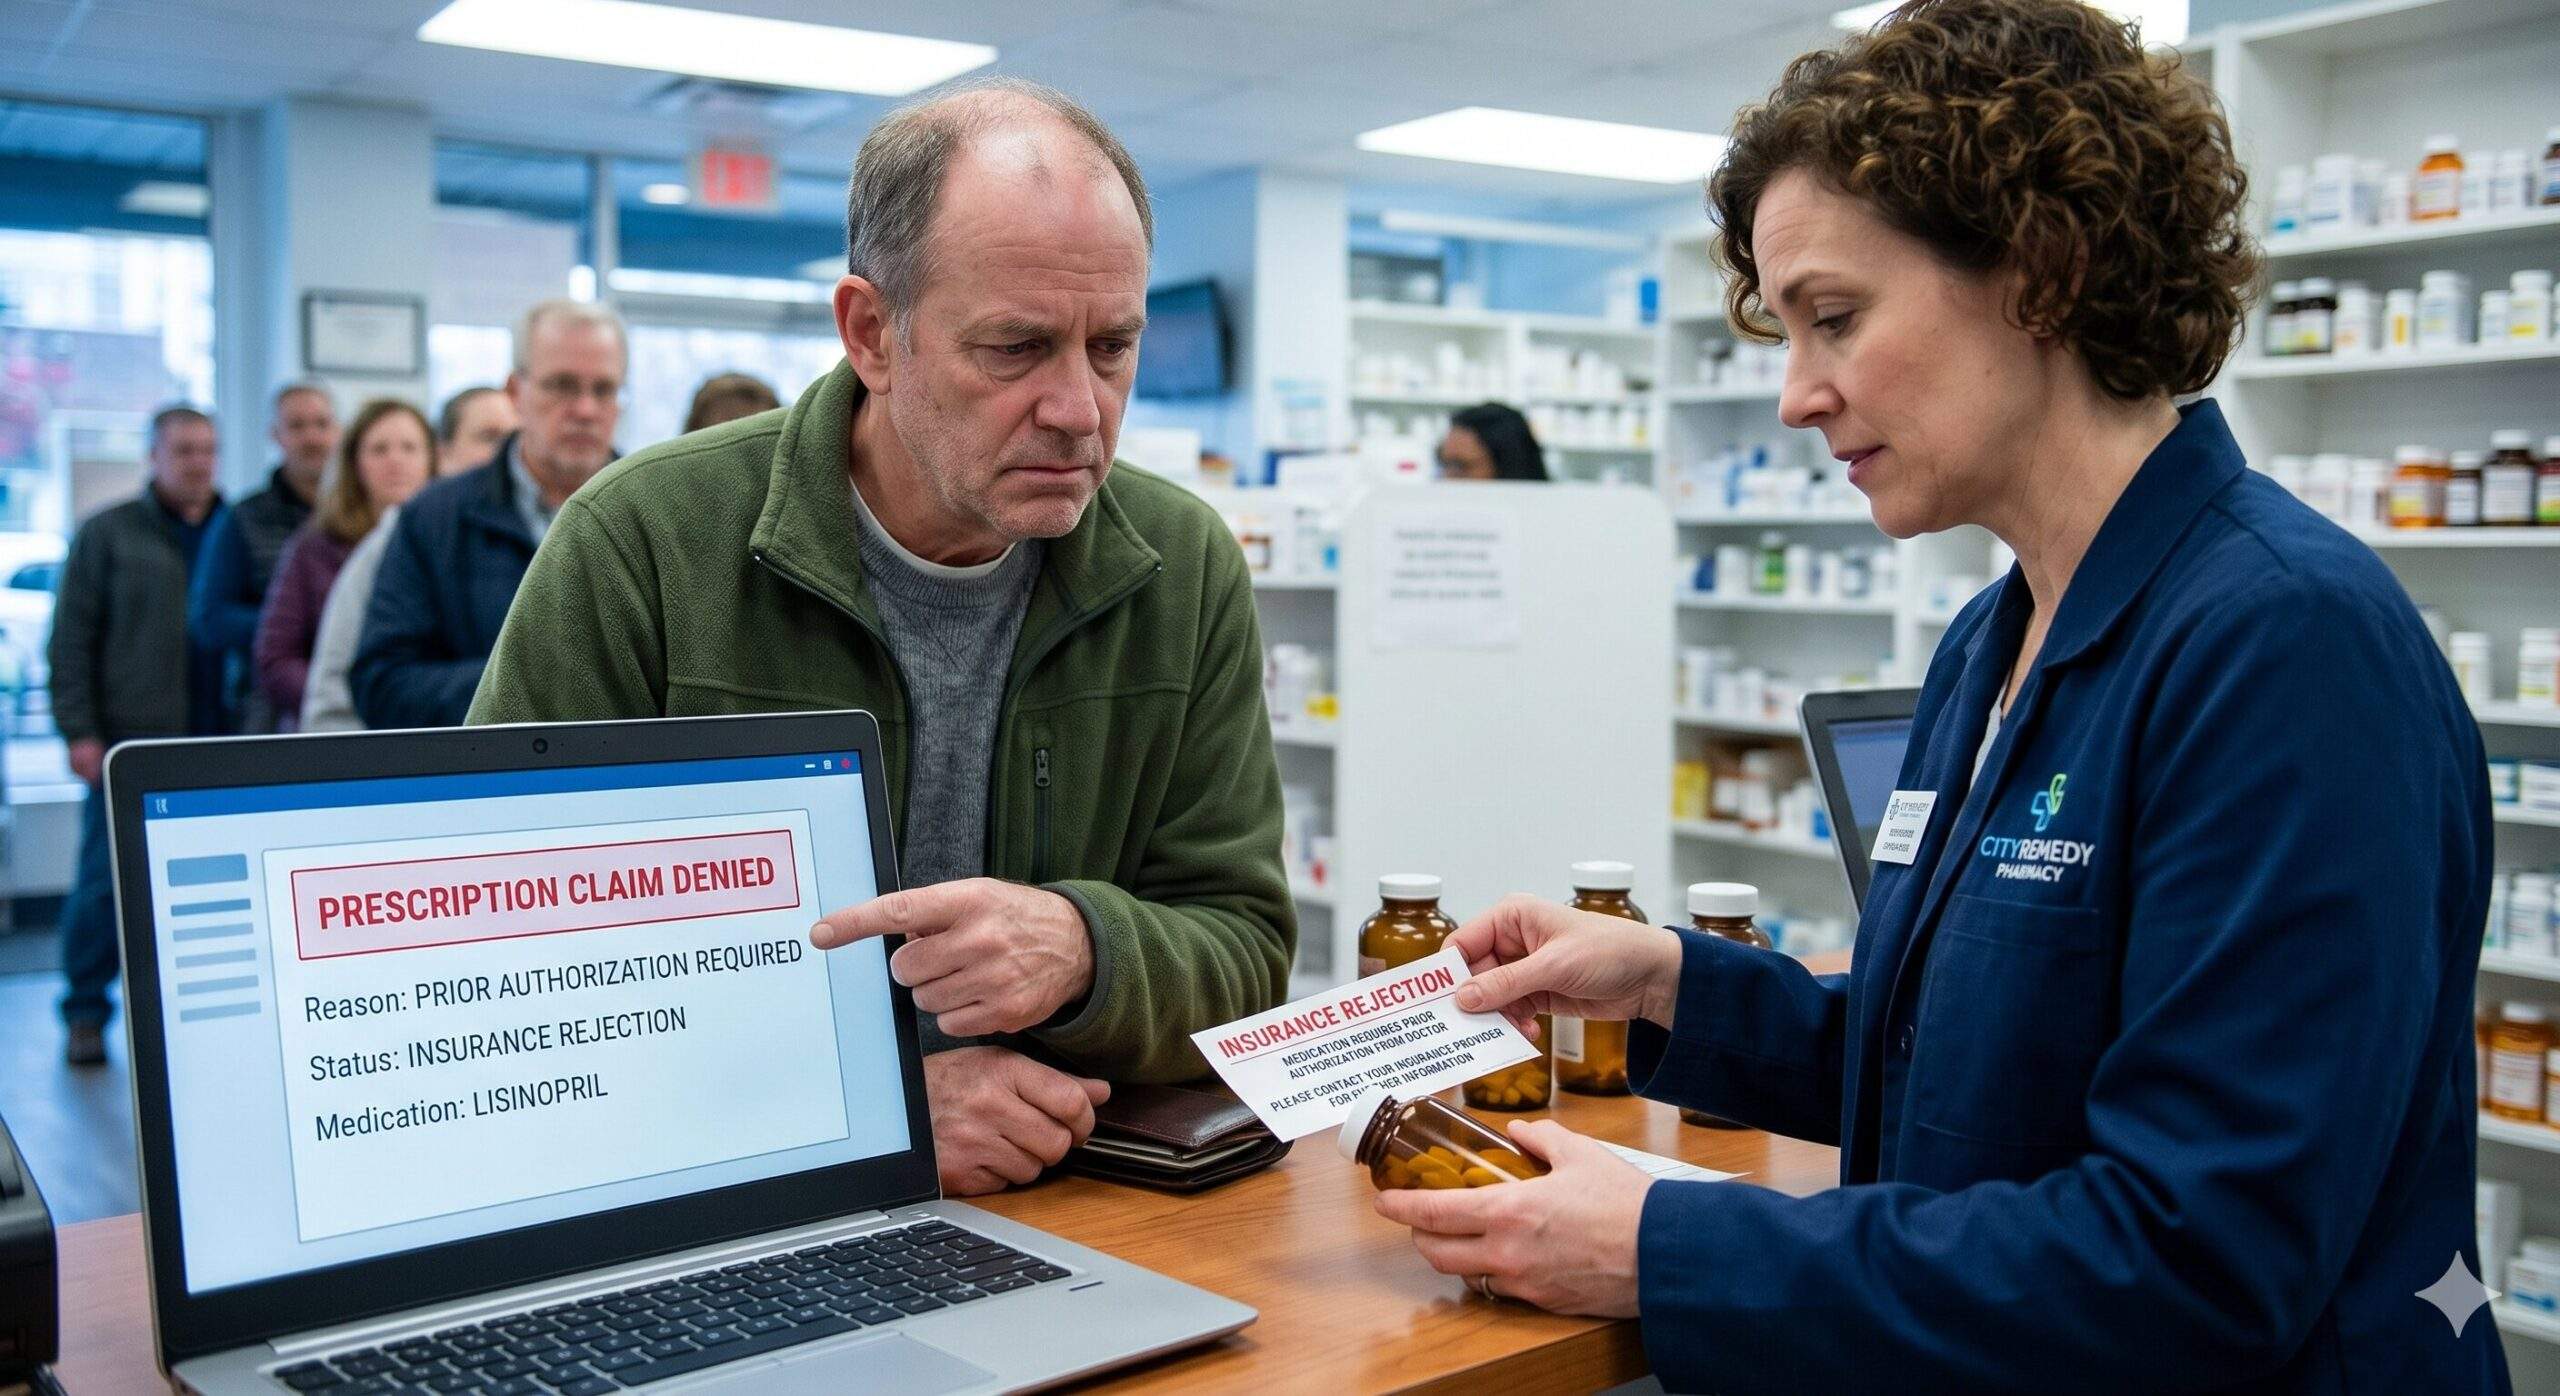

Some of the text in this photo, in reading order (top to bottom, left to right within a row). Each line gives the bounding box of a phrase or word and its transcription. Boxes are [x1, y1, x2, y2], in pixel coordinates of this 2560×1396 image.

[1980, 836, 2095, 866] CITYREMEDY
[1995, 863, 2064, 882] PHARMACY
[318, 856, 775, 929] PRESCRIPTION CLAIM DENIED
[305, 939, 803, 1022] Reason: PRIOR AUTHORIZATION REQUIRED
[1218, 966, 1455, 1058] INSURANCE REJECTION
[310, 1006, 687, 1081] Status: INSURANCE REJECTION
[1270, 1090, 1316, 1112] PLEASE
[1314, 1074, 1364, 1098] CONTACT
[1364, 1064, 1396, 1080] YOUR
[1452, 1028, 1505, 1056] PROVIDER
[1282, 1010, 1436, 1067] MEDICATION REQUIRES PRIOR
[1289, 1022, 1449, 1080] AUTHORIZATION FROM DOCTOR
[315, 1073, 608, 1141] Medication: LISINOPRIL
[1328, 1093, 1352, 1108] FOR
[1401, 1052, 1475, 1083] INFORMATION
